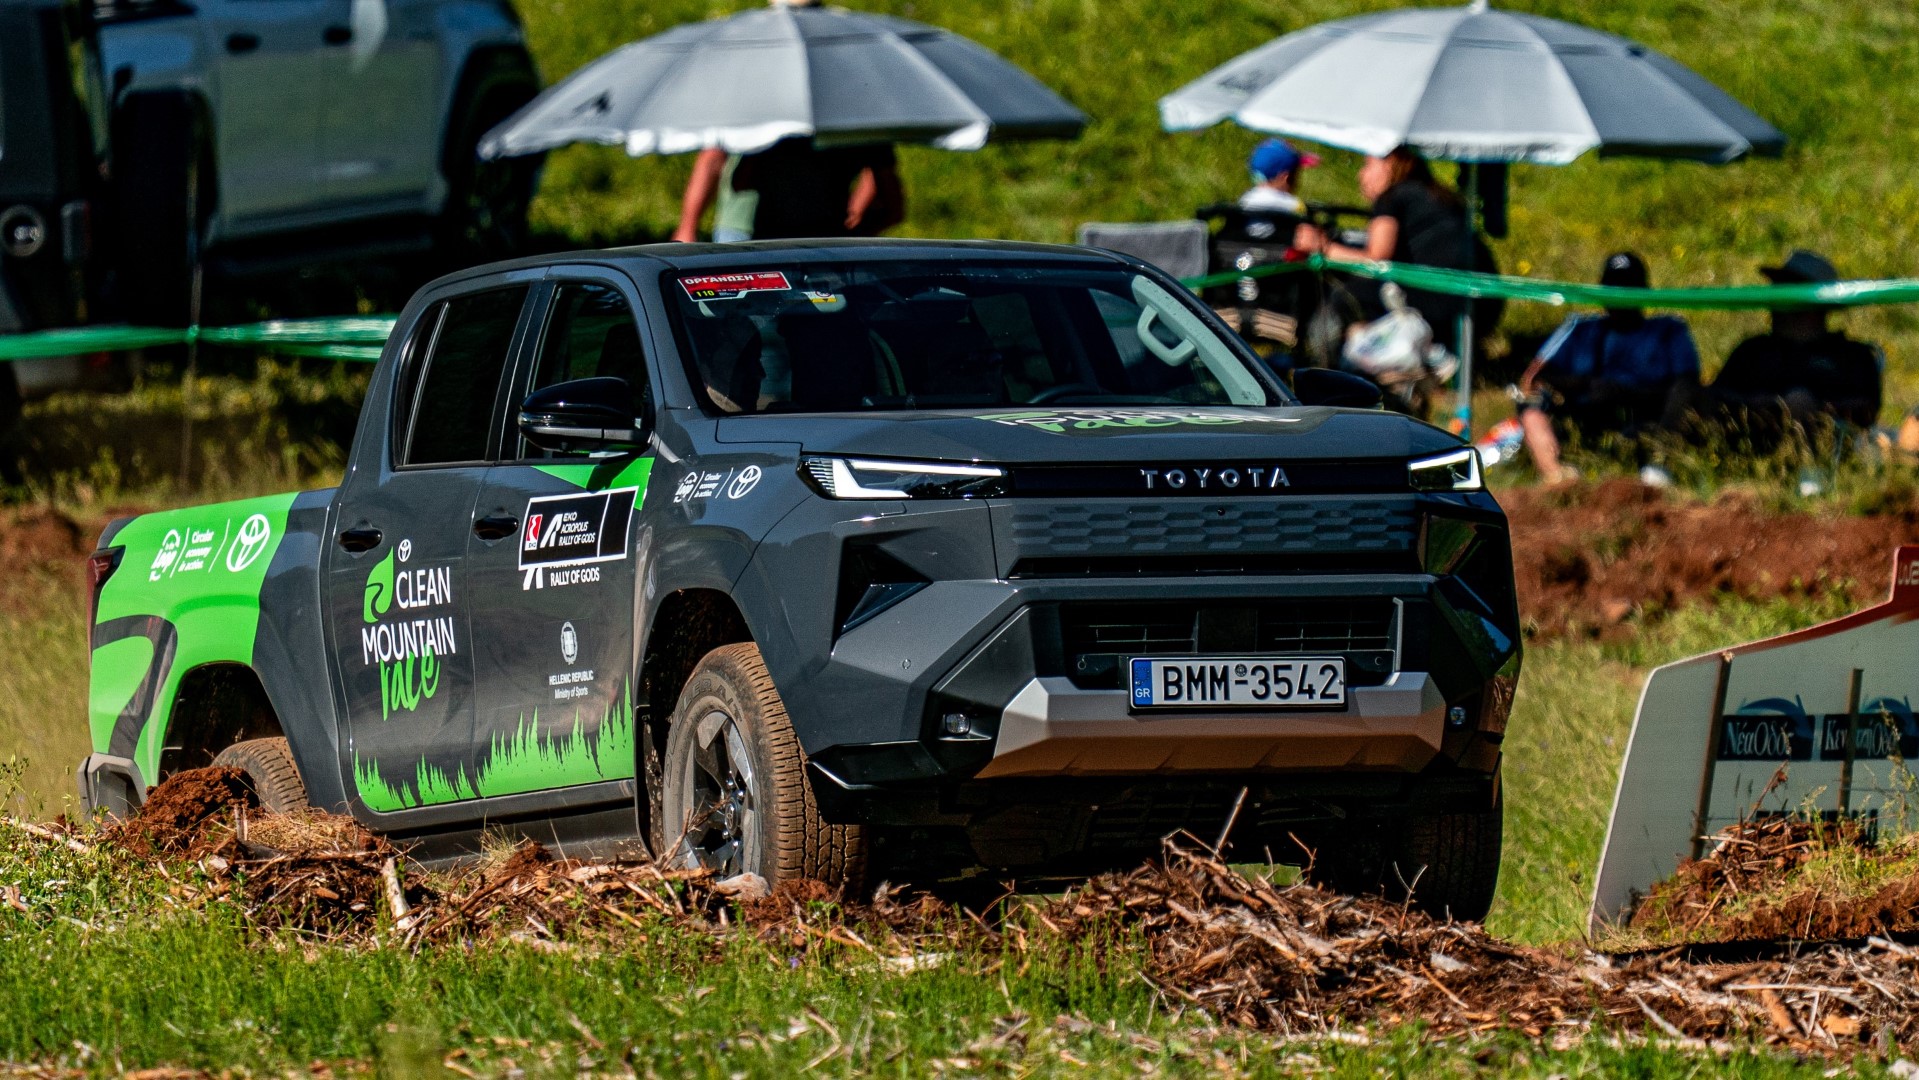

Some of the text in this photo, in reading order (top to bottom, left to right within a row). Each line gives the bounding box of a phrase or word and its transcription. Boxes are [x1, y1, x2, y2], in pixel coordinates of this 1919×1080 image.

[1140, 467, 1290, 489] TOYOTA
[563, 511, 577, 522] EKO
[560, 521, 589, 534] ACROPOLIS
[558, 532, 596, 547] RALLY OF GODS
[550, 567, 600, 587] RALLY OF GODS
[395, 566, 451, 609] CLEAN
[362, 616, 456, 666] MOUNTAIN
[380, 644, 441, 722] race
[549, 669, 594, 686] HELLENIC REPUBLIC
[1162, 663, 1340, 701] BMM-3542
[554, 688, 571, 700] Ministry
[575, 685, 589, 698] Sports
[1135, 688, 1151, 698] GR
